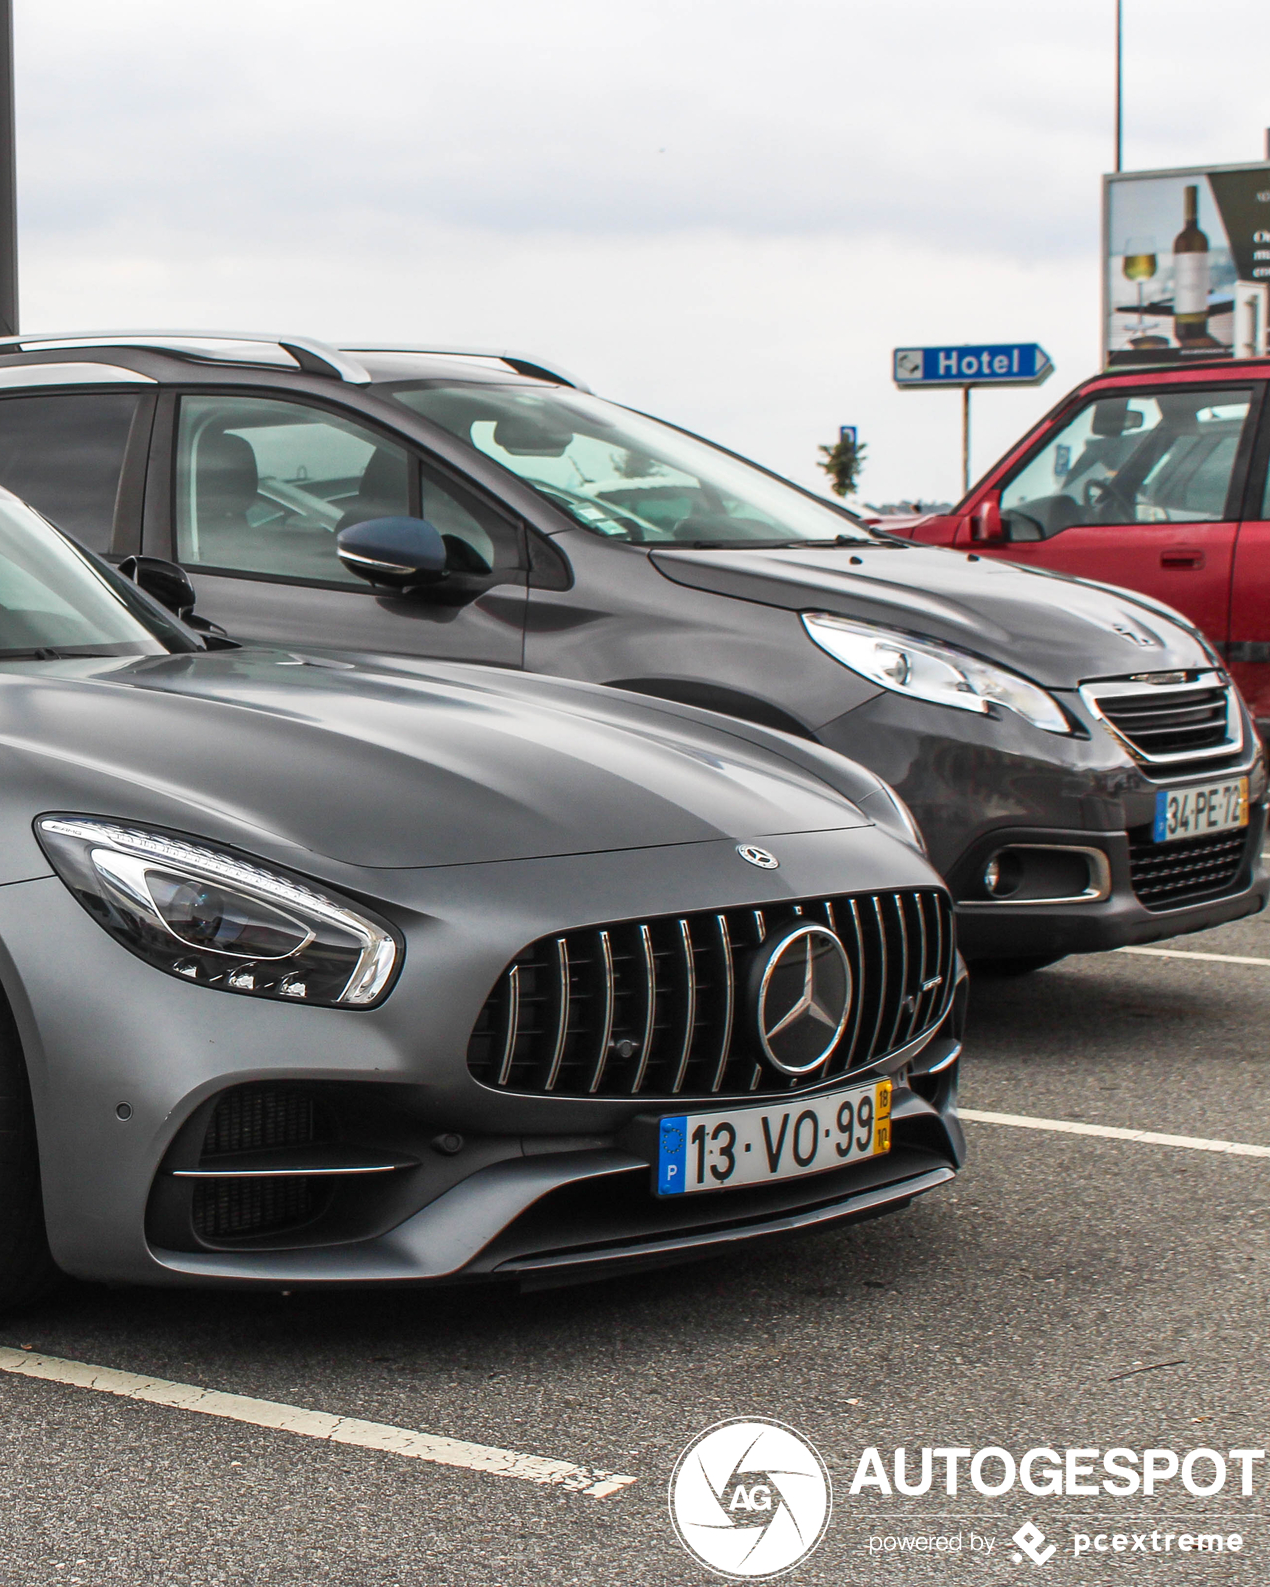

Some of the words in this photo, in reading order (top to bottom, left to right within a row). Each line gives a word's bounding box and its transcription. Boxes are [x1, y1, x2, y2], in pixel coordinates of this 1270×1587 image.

[938, 349, 1020, 375] Hotel
[879, 1089, 888, 1108] 18
[667, 1164, 678, 1181] P
